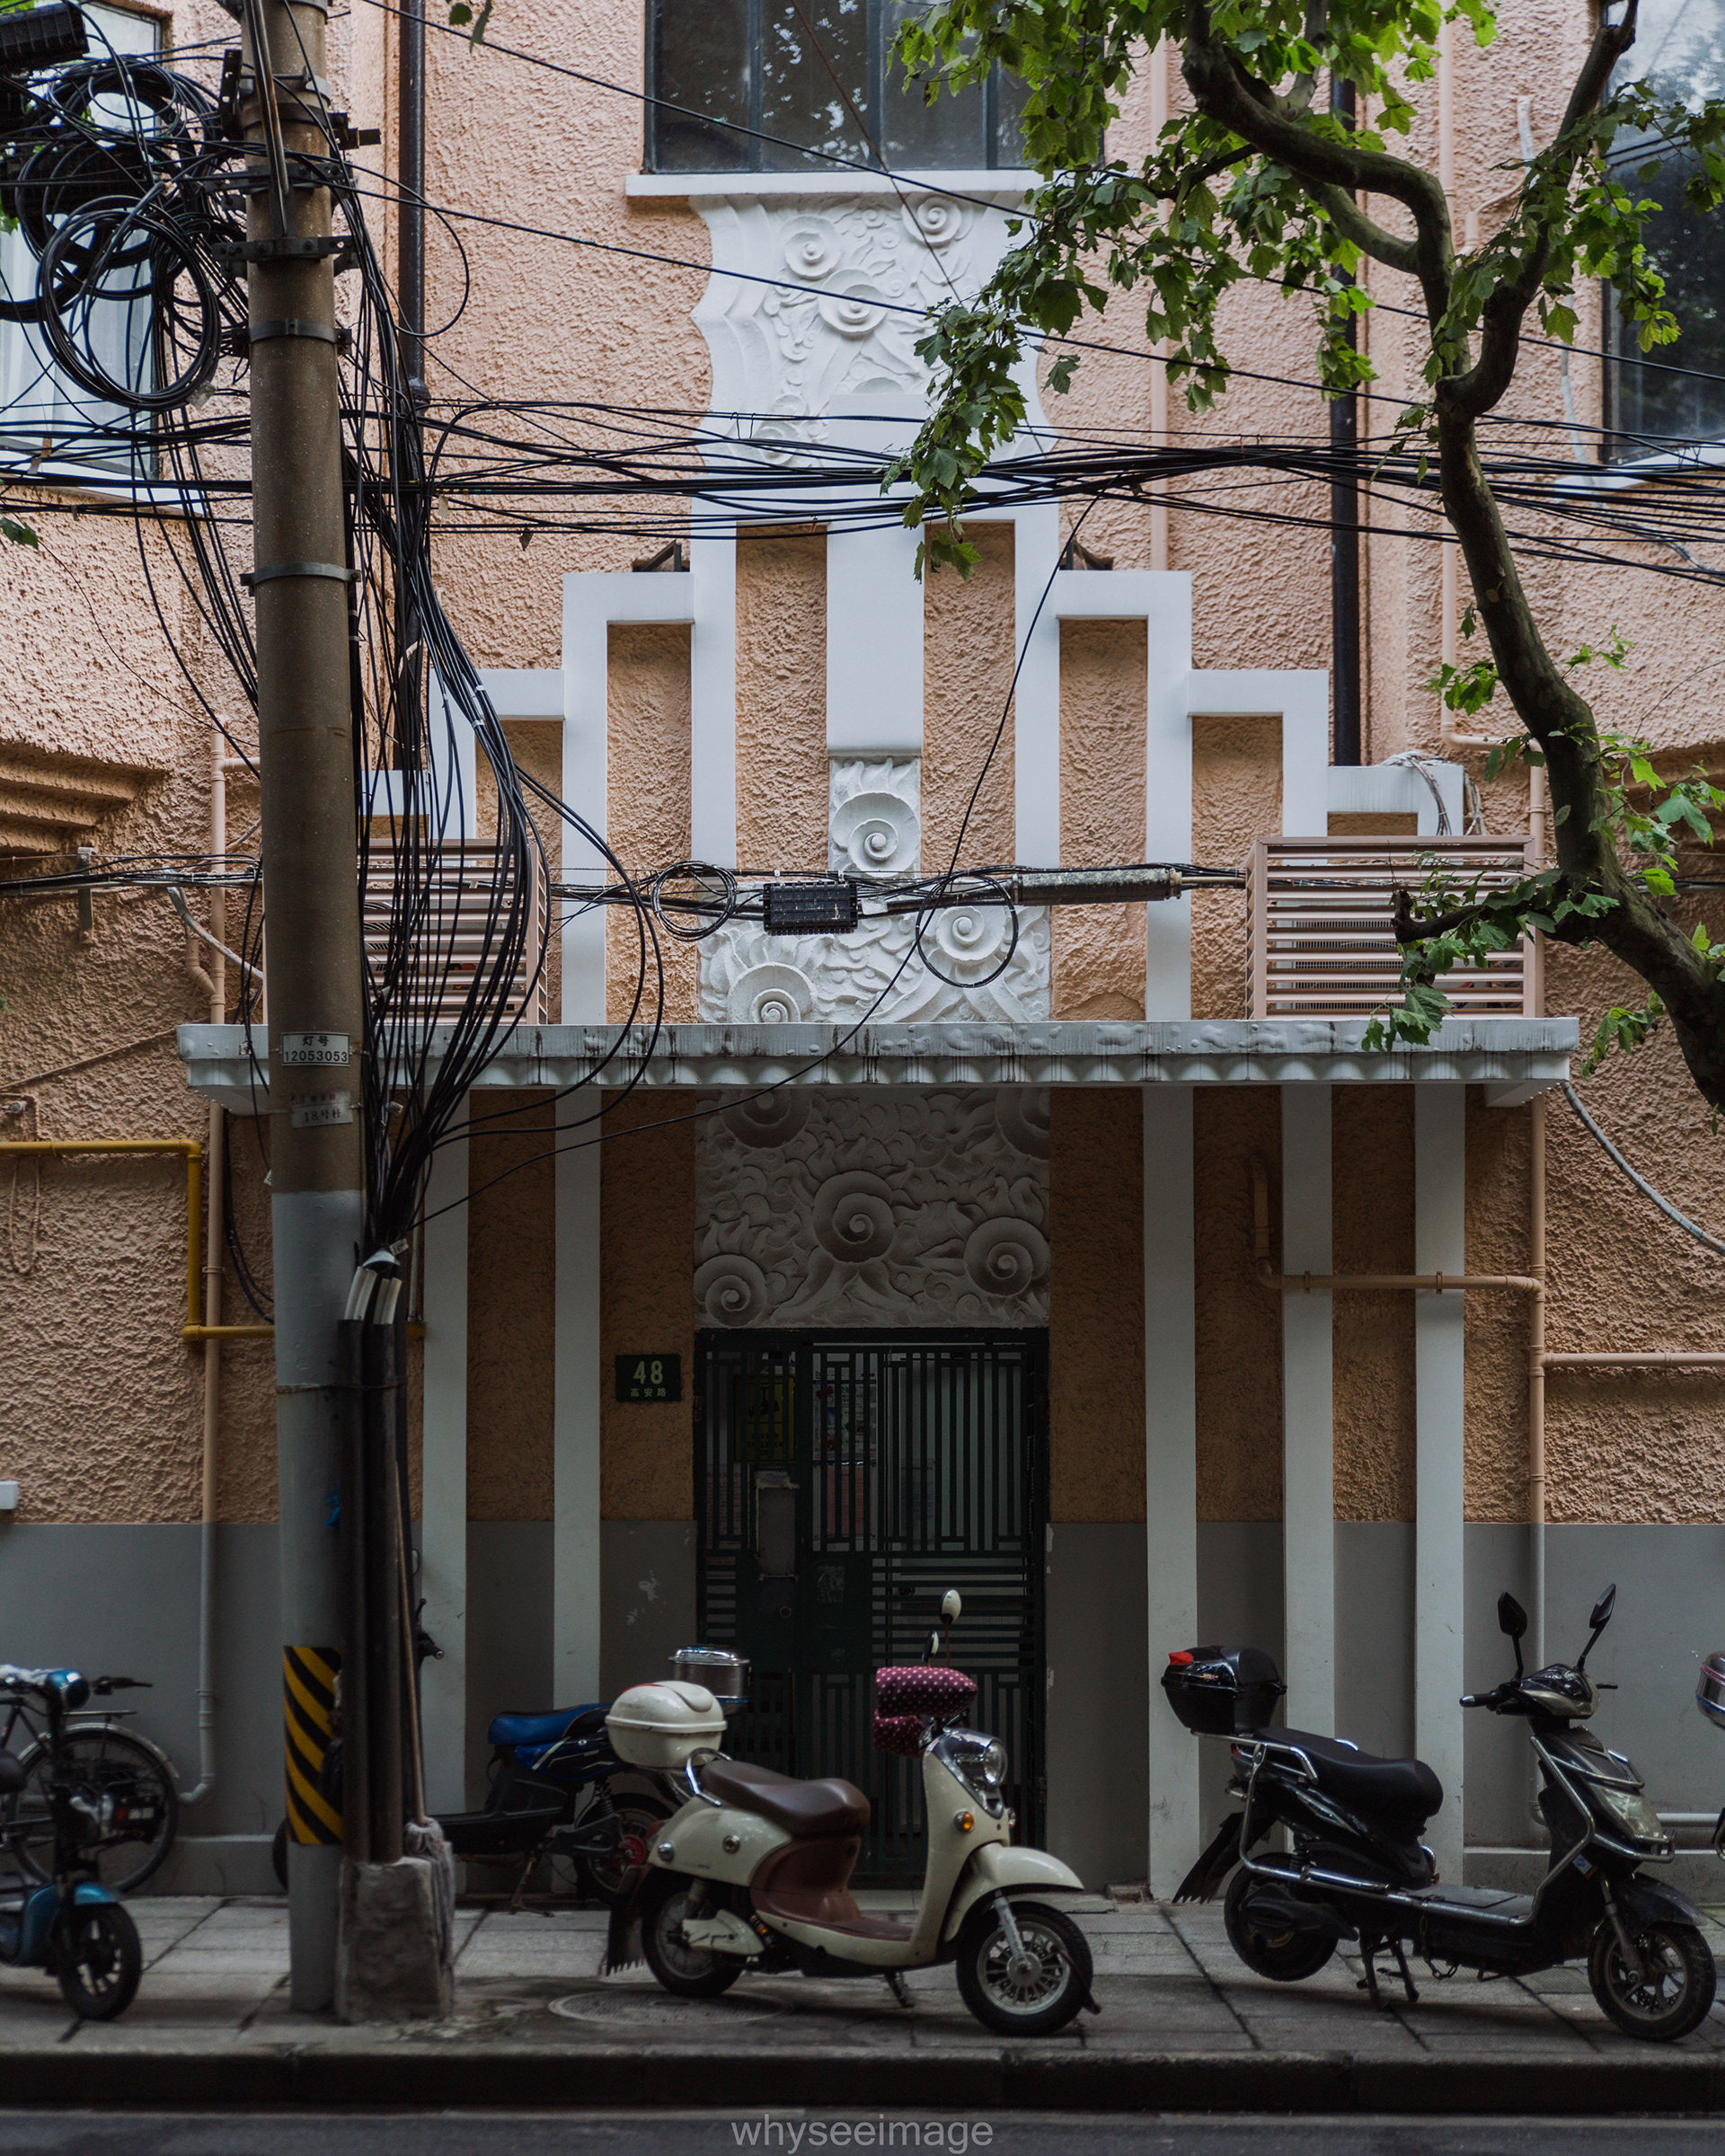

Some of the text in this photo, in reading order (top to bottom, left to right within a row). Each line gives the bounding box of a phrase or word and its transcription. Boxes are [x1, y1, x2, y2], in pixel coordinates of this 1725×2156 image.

[303, 1036, 329, 1047] 灯号
[285, 1050, 348, 1062] 12053053
[633, 1360, 663, 1384] 48
[631, 1388, 667, 1397] 高安路
